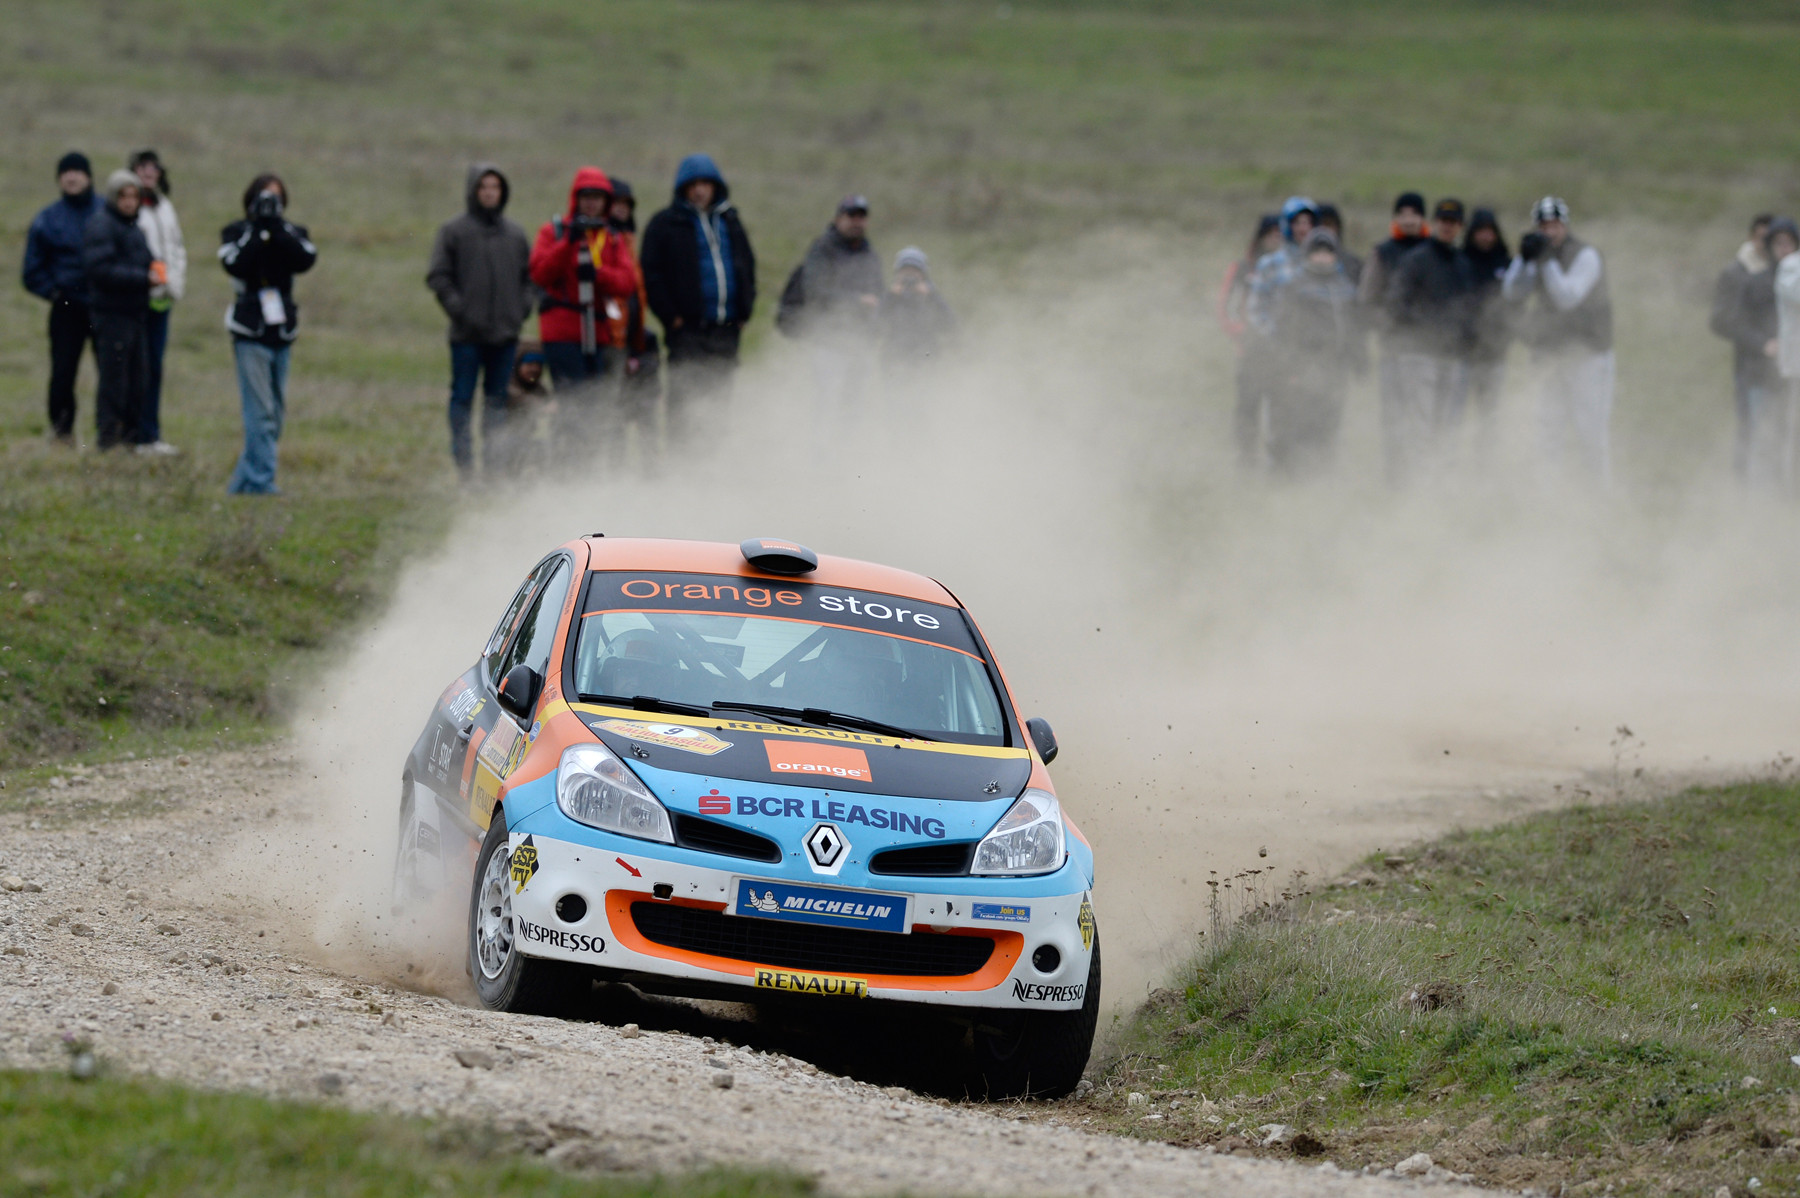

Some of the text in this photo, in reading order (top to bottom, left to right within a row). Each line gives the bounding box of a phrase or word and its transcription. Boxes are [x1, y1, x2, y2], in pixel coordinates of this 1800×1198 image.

[621, 580, 940, 630] Orange store
[663, 727, 684, 735] 9
[728, 721, 888, 744] RENAULT
[736, 796, 946, 839] BCR LEASING
[512, 846, 537, 867] GSP
[513, 867, 530, 887] TV
[783, 896, 892, 918] MICHELIN
[1000, 906, 1013, 915] Join
[517, 914, 606, 954] NESPRESSO
[757, 971, 866, 996] RENAULT
[1012, 978, 1084, 1002] NESPRESSO
